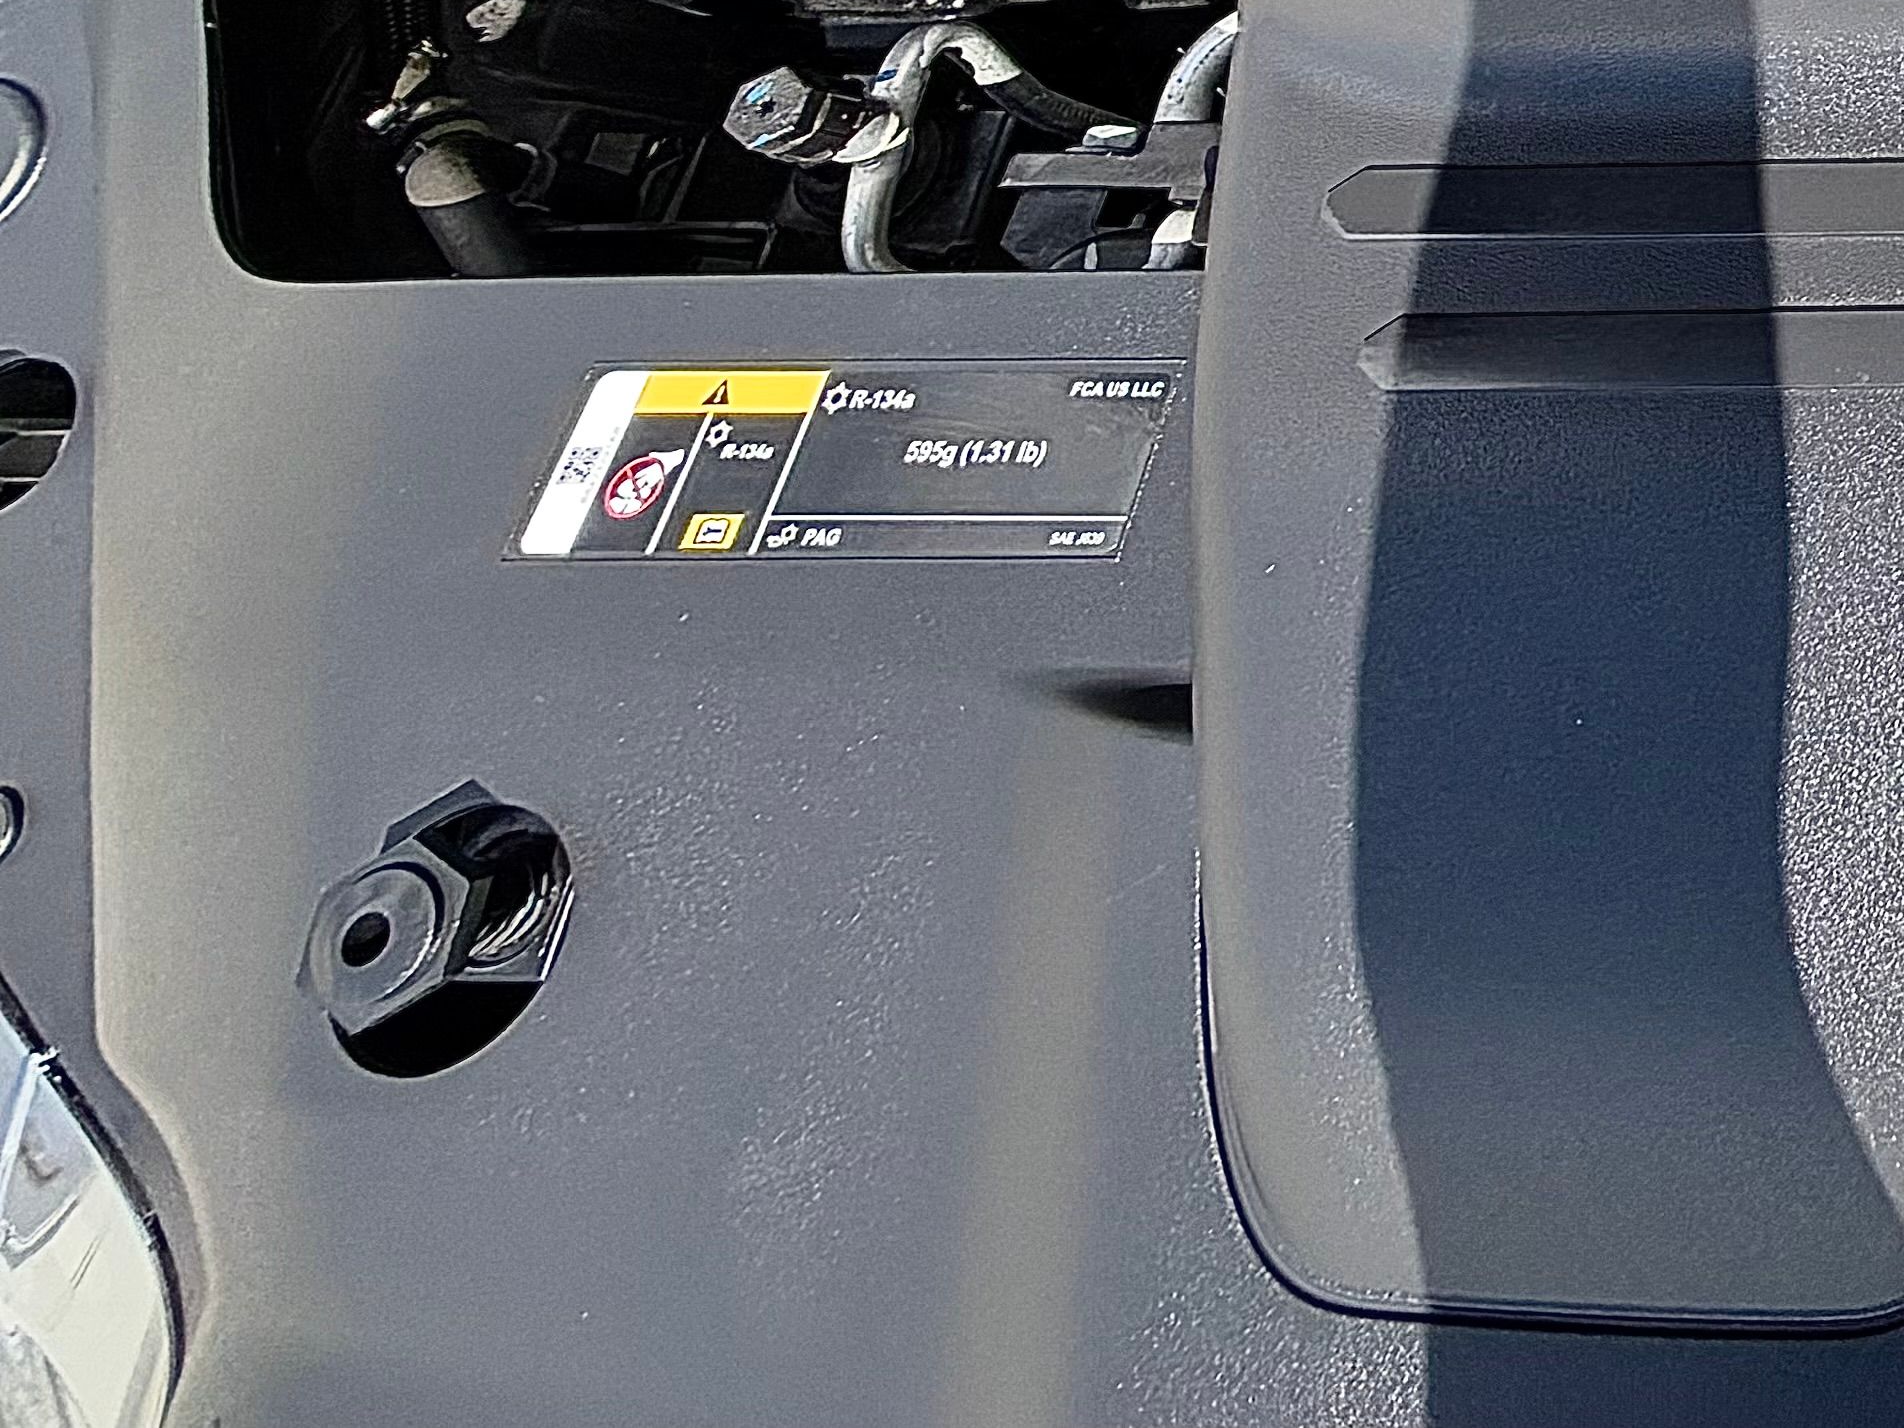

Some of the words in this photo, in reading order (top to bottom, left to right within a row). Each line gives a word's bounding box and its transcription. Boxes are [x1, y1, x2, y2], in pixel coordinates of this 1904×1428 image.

[849, 388, 917, 409] R-134a
[1068, 381, 1104, 397] FCA
[1105, 381, 1131, 397] US
[1130, 381, 1166, 397] LLC
[903, 440, 959, 468] 595g
[959, 440, 1015, 468] (1.31
[1015, 440, 1048, 468] lb)
[800, 528, 842, 547] PAG
[1048, 531, 1077, 546] SAE
